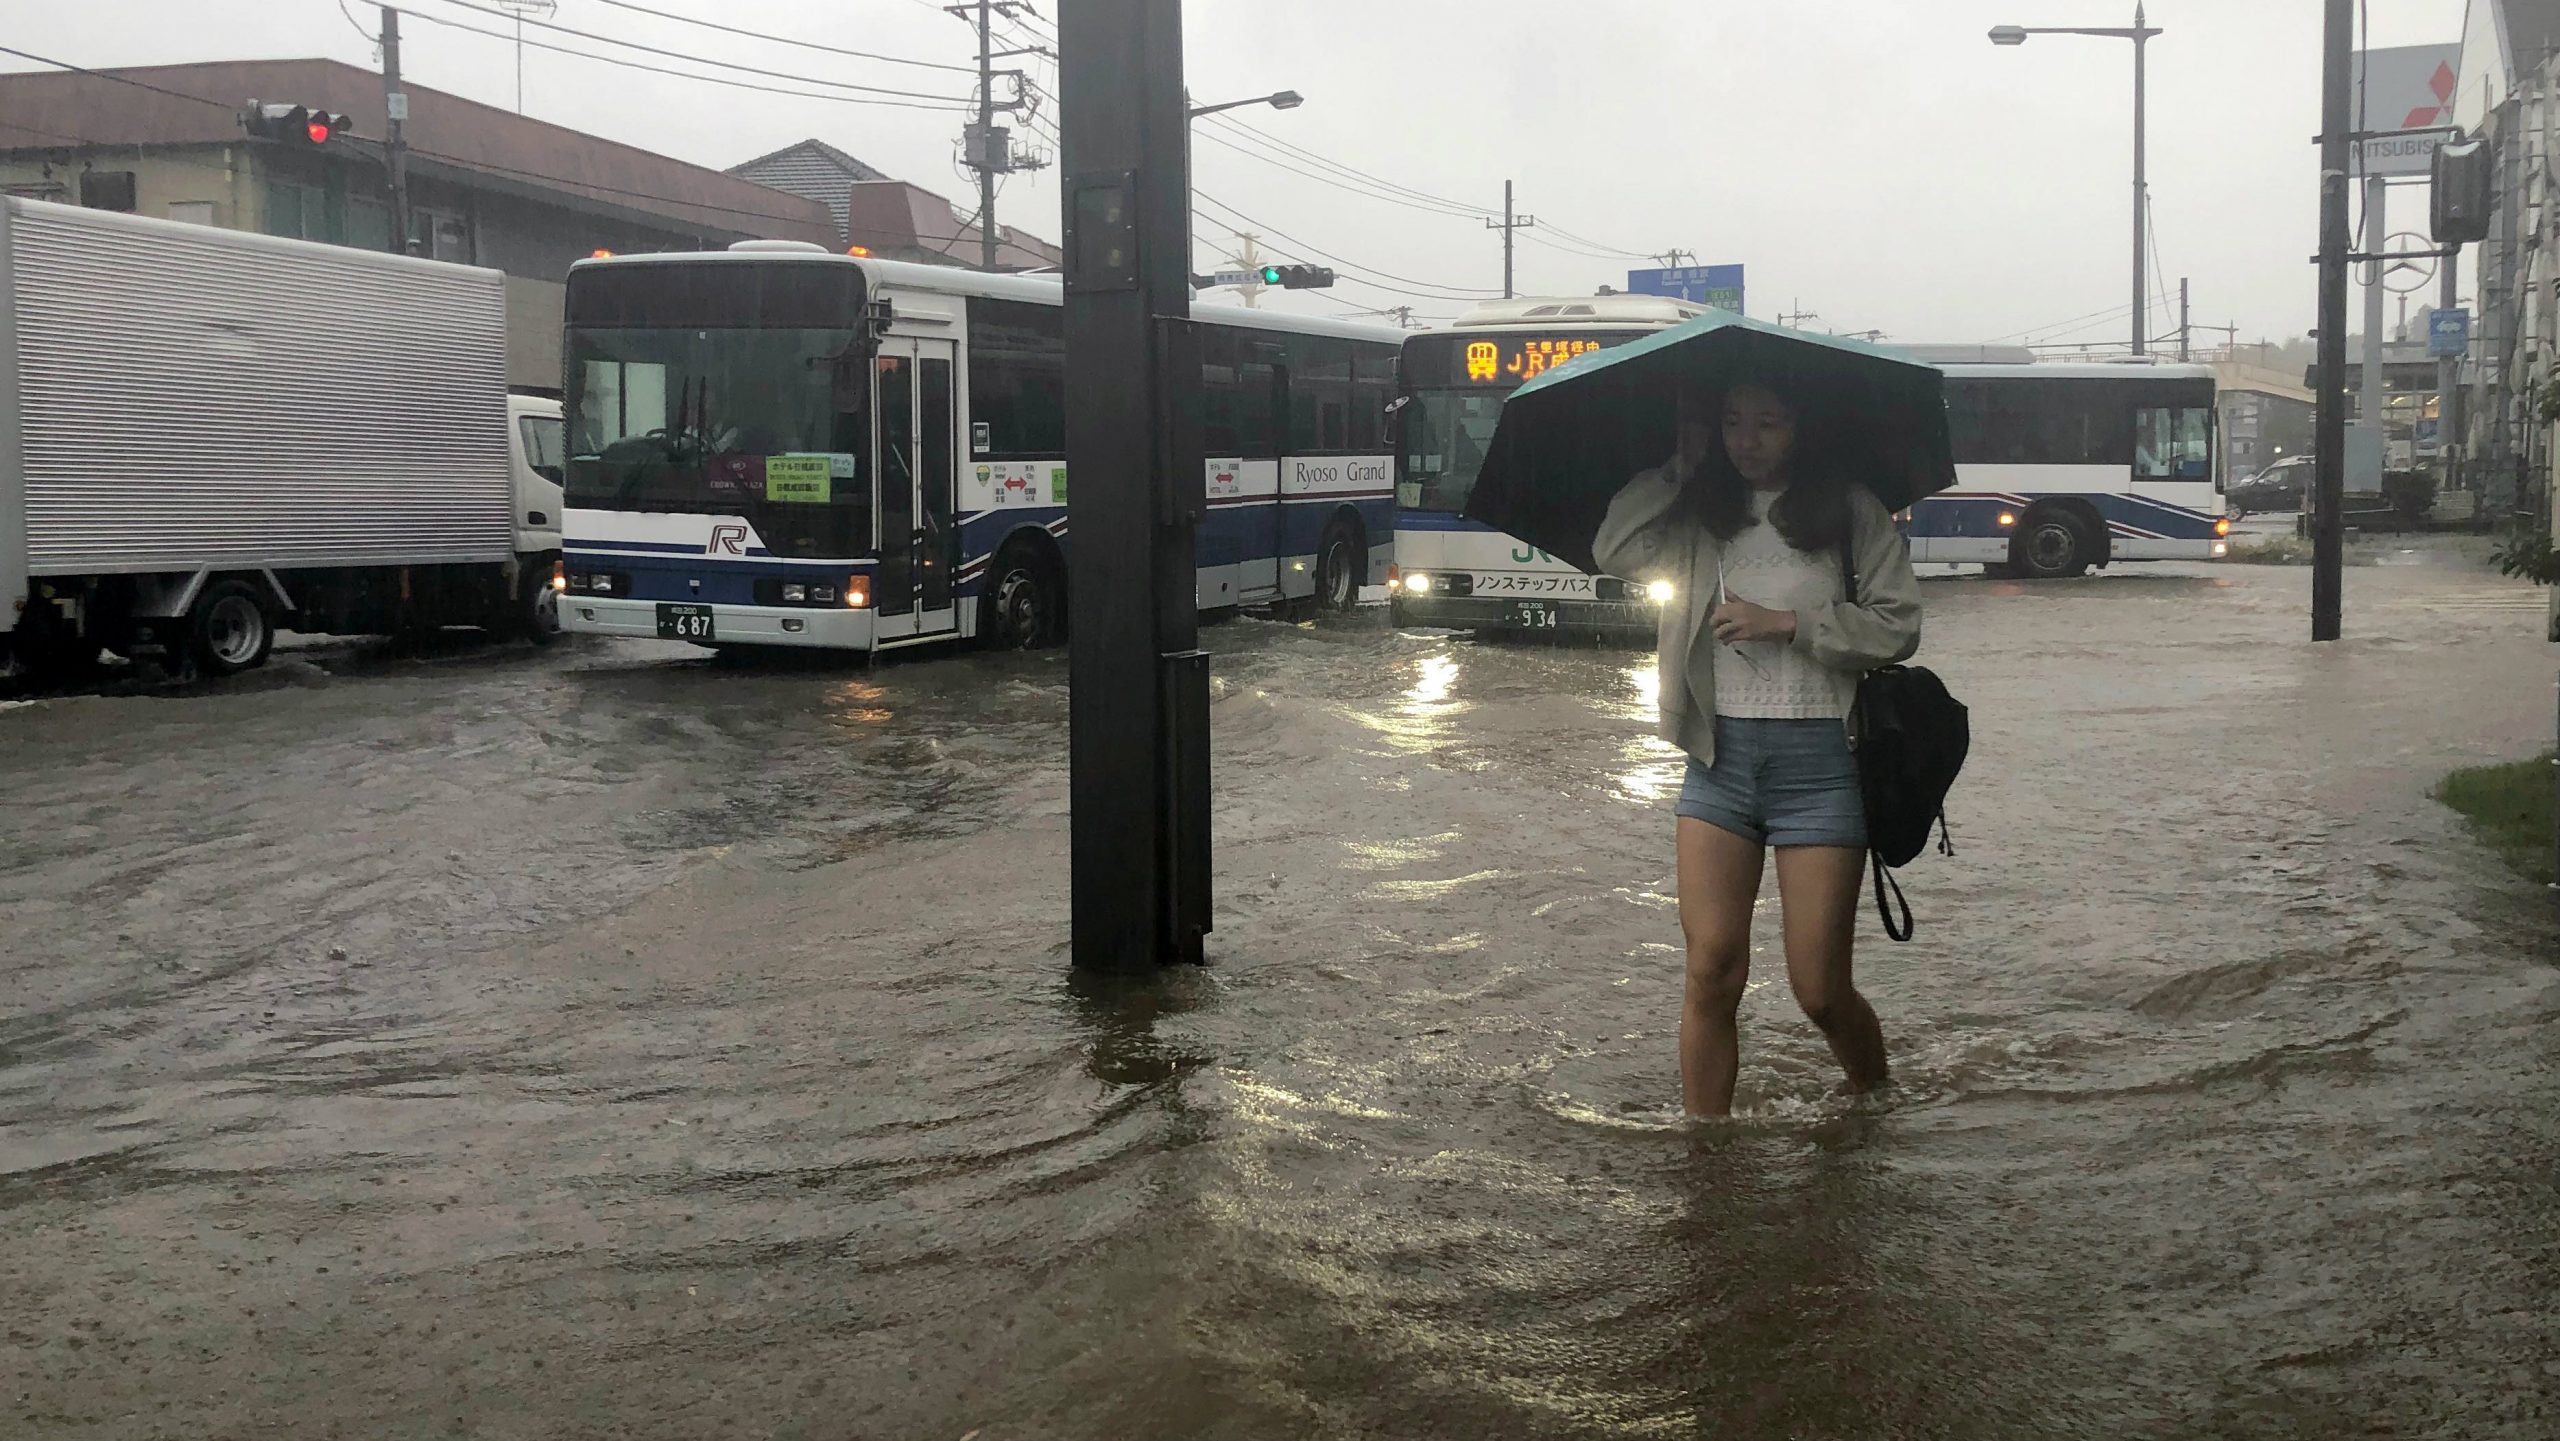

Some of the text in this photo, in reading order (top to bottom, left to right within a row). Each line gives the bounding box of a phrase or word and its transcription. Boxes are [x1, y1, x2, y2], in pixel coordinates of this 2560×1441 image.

[2351, 139, 2437, 159] MITSUBIS
[1296, 460, 1386, 490] Ryoso Grand
[709, 525, 748, 555] R
[1476, 576, 1592, 593] ノンステップバス
